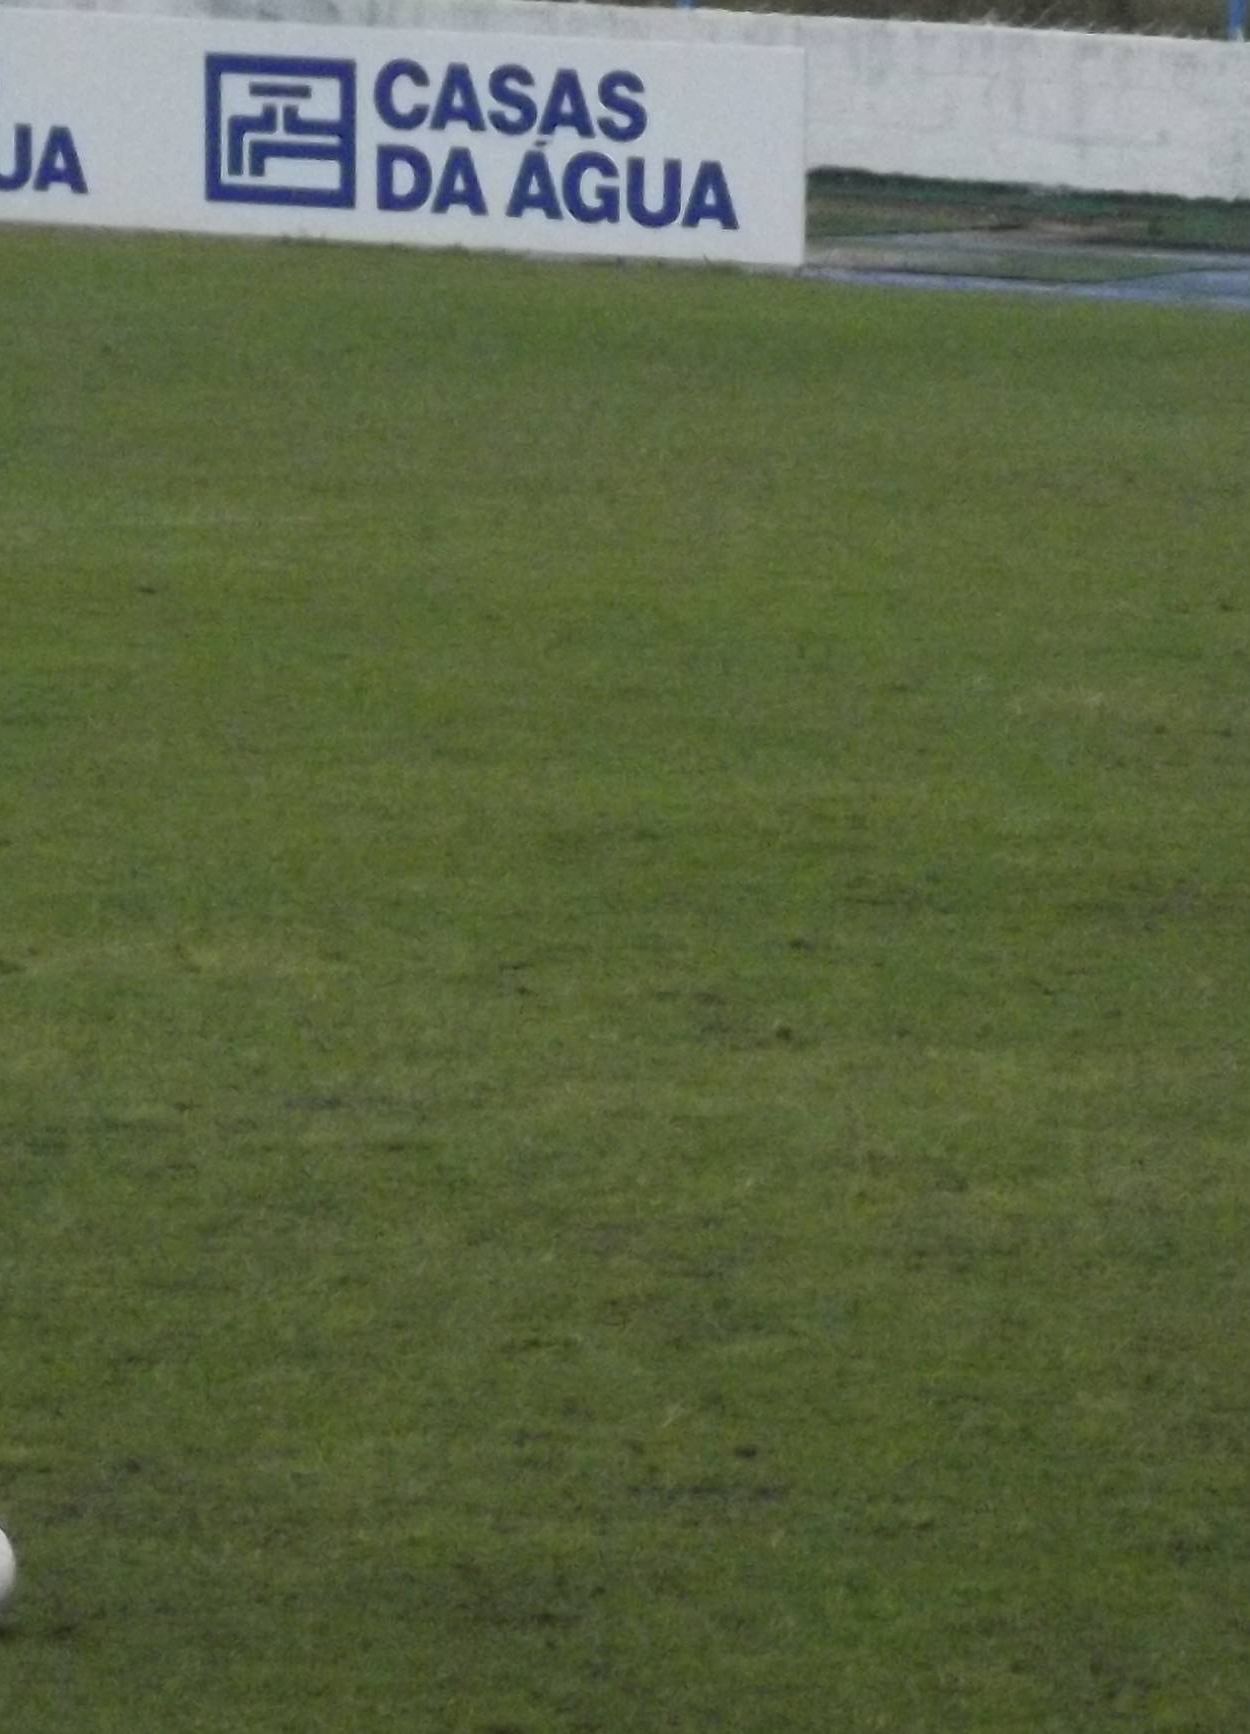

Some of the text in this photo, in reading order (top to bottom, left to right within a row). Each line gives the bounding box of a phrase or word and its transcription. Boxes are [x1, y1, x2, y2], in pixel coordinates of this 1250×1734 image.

[373, 58, 648, 142] CASAS
[376, 140, 739, 230] DA ÁGUA
